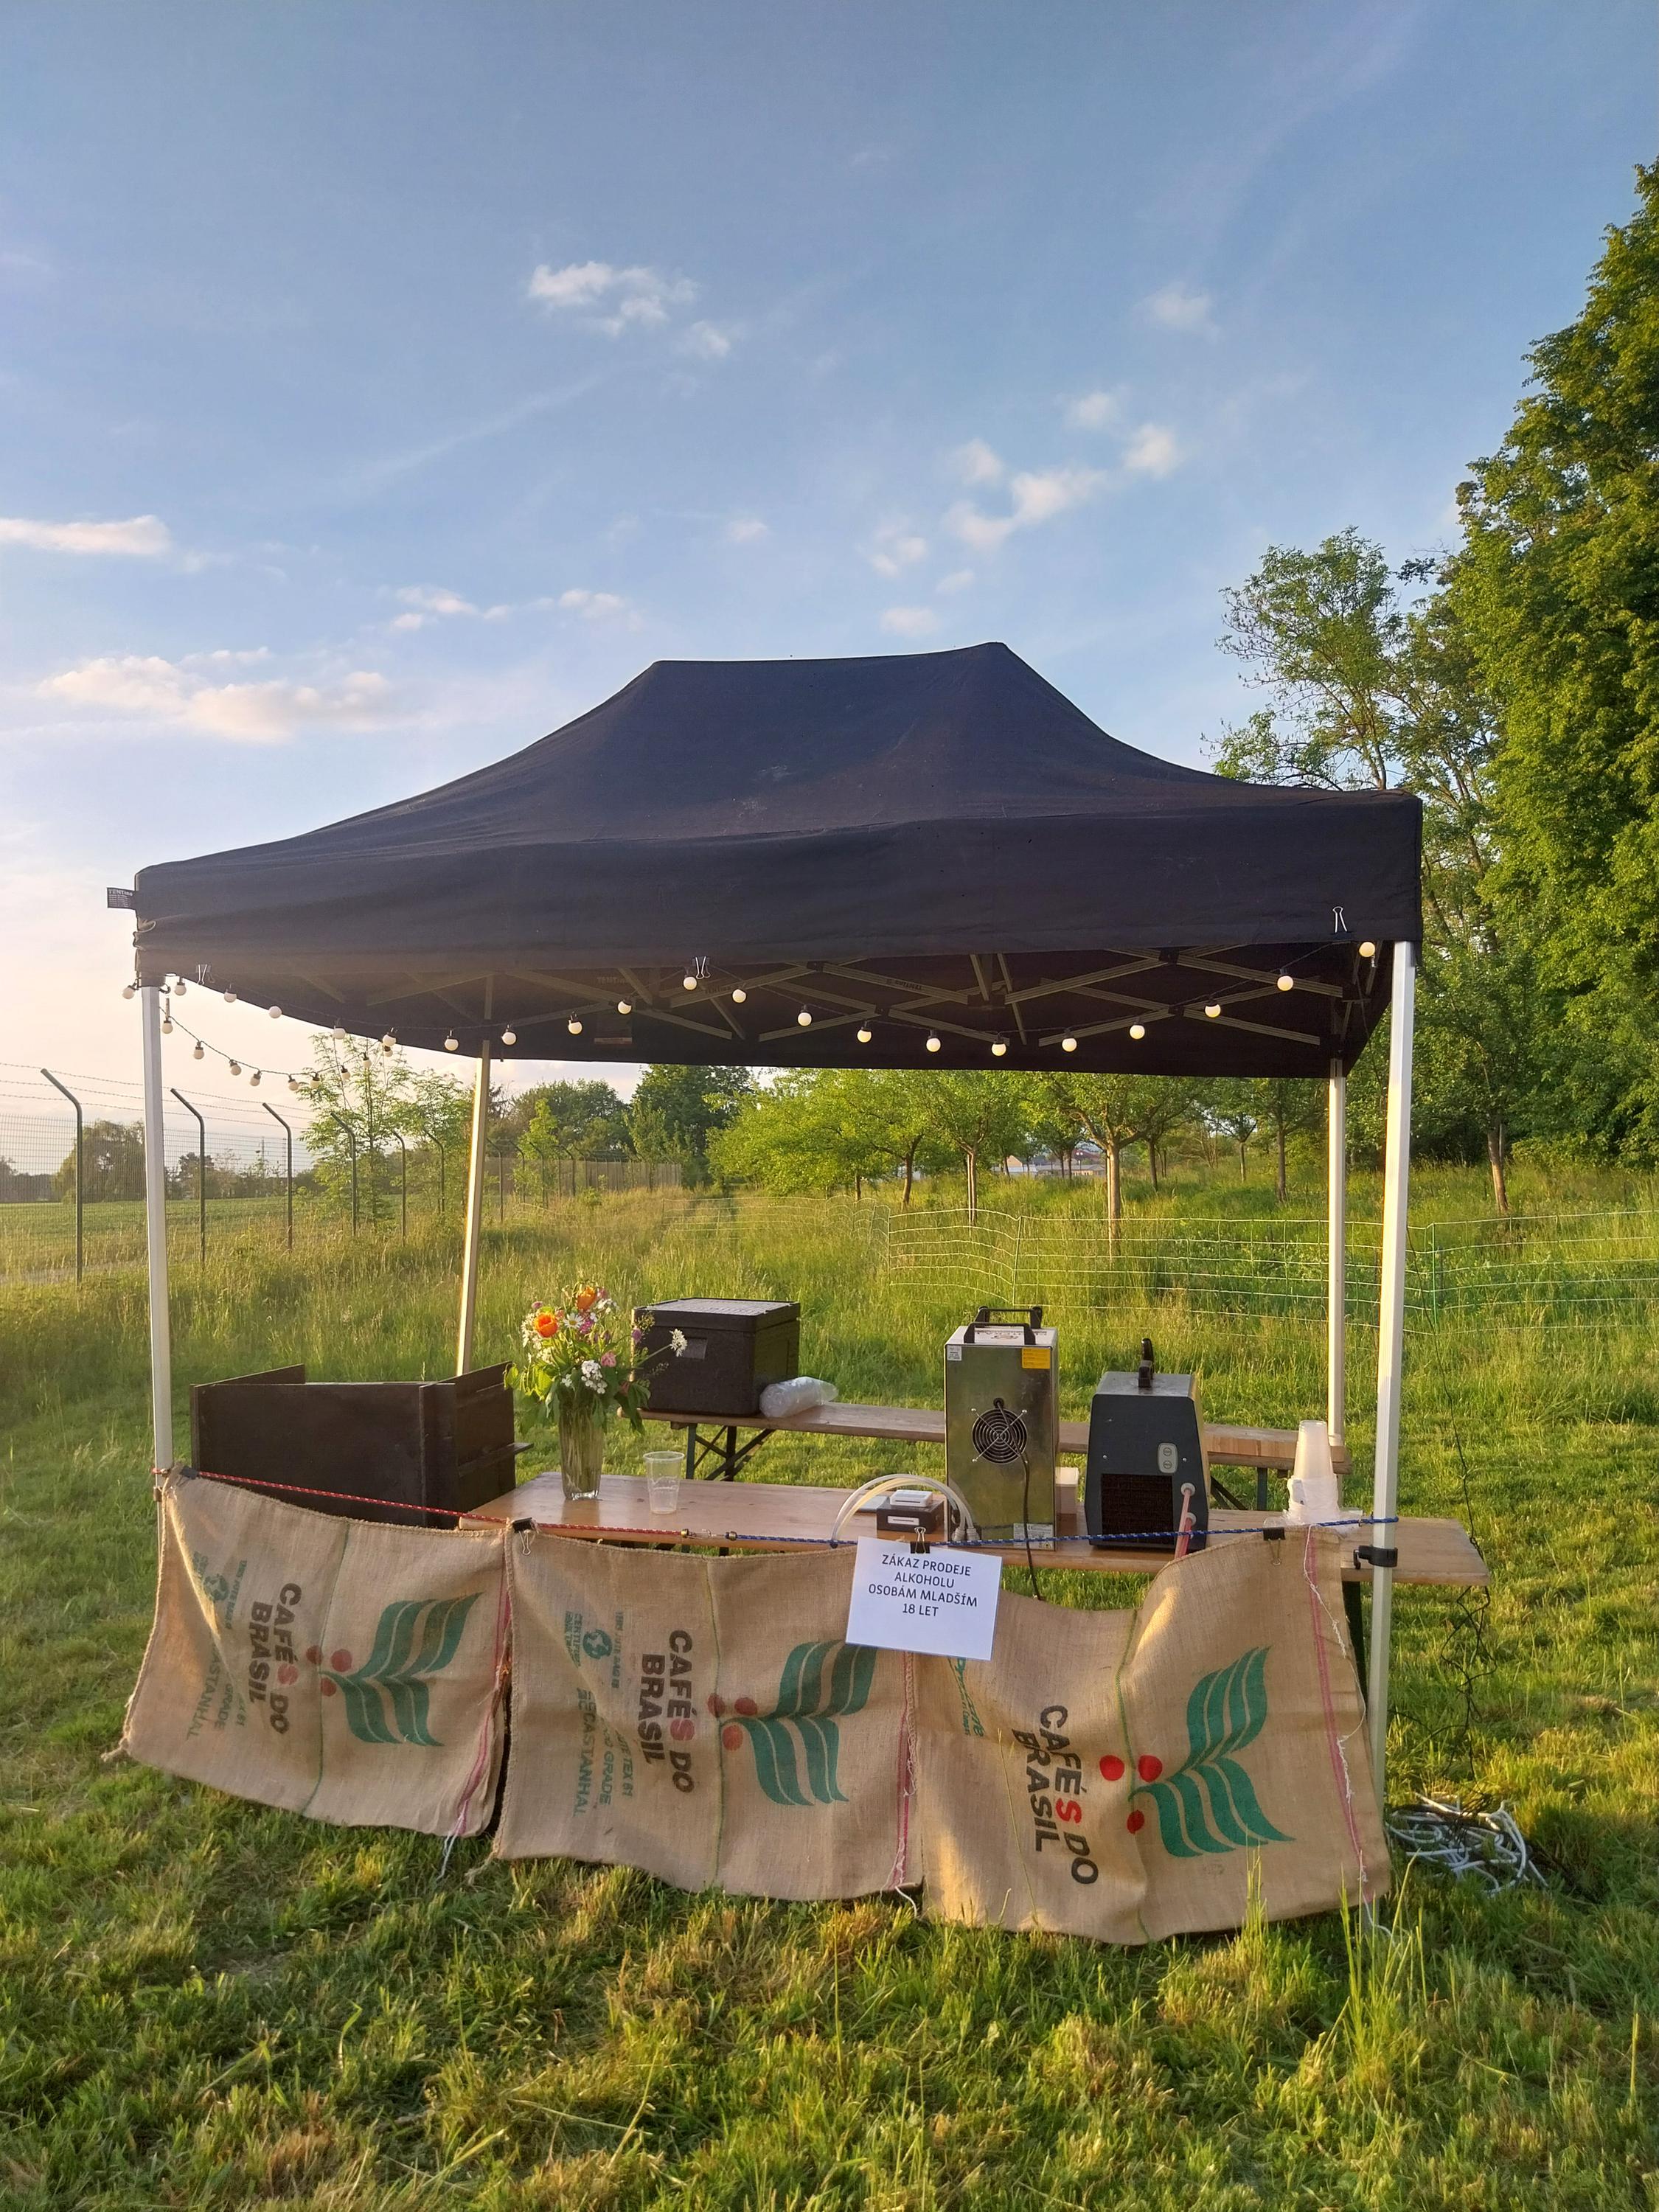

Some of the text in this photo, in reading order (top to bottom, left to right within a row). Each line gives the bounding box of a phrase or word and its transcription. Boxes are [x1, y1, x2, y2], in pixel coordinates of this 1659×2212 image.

[869, 1583, 978, 1607] OSOBÁM MLADŠÍM
[882, 1553, 972, 1576] ZÁKAZ PRODEJE
[894, 1571, 955, 1588] ALKOHOLU
[902, 1603, 939, 1617] 18 LET
[248, 1601, 273, 1703] BRASIL
[270, 1582, 302, 1734] CAFÉS DO
[638, 1653, 665, 1764] BRASIL
[667, 1630, 698, 1793] CAFÉS DO
[599, 1750, 614, 1805] GRADE
[1012, 1728, 1060, 1852] BRASIL
[1040, 1705, 1099, 1885] CAFÉS DO
